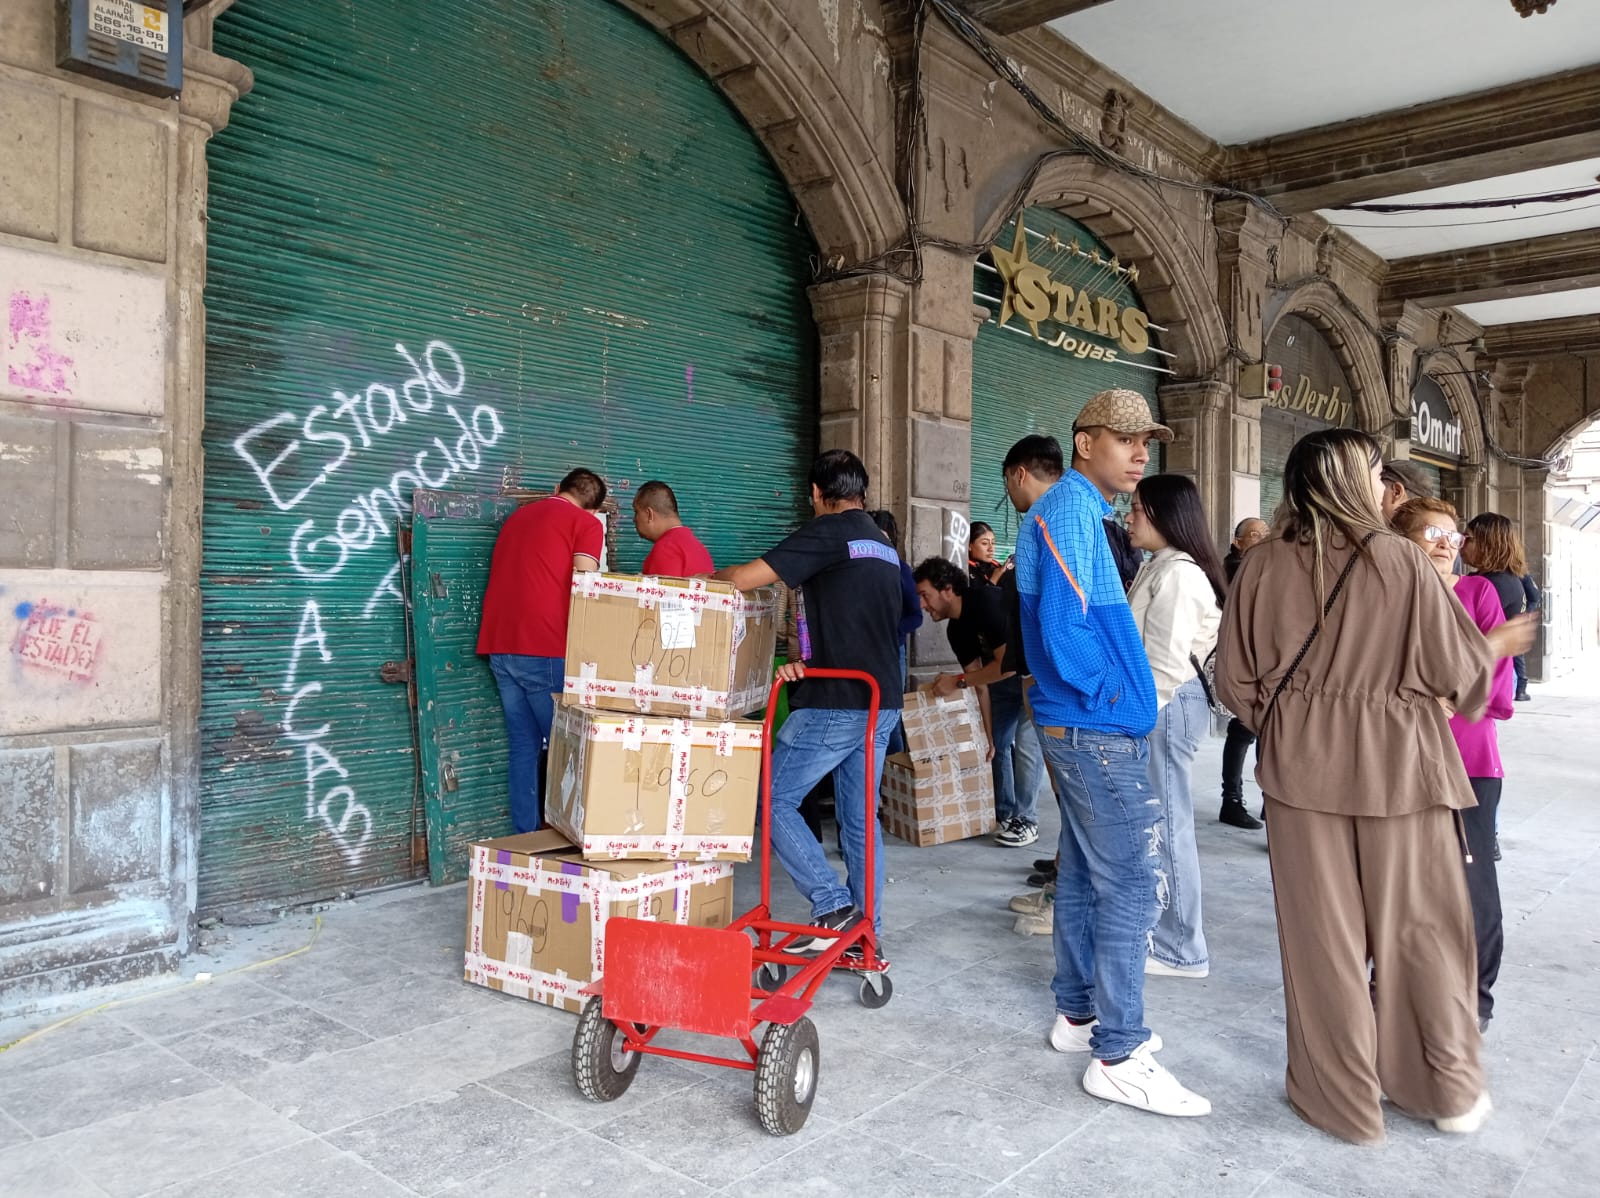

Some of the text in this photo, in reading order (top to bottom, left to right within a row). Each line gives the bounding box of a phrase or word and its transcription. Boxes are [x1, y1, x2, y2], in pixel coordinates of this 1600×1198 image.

[95, 5, 134, 23] ALARMAS
[1013, 266, 1149, 355] STARS
[1047, 331, 1118, 363] Joyas
[234, 340, 465, 511] Estado
[1289, 374, 1351, 429] Derby
